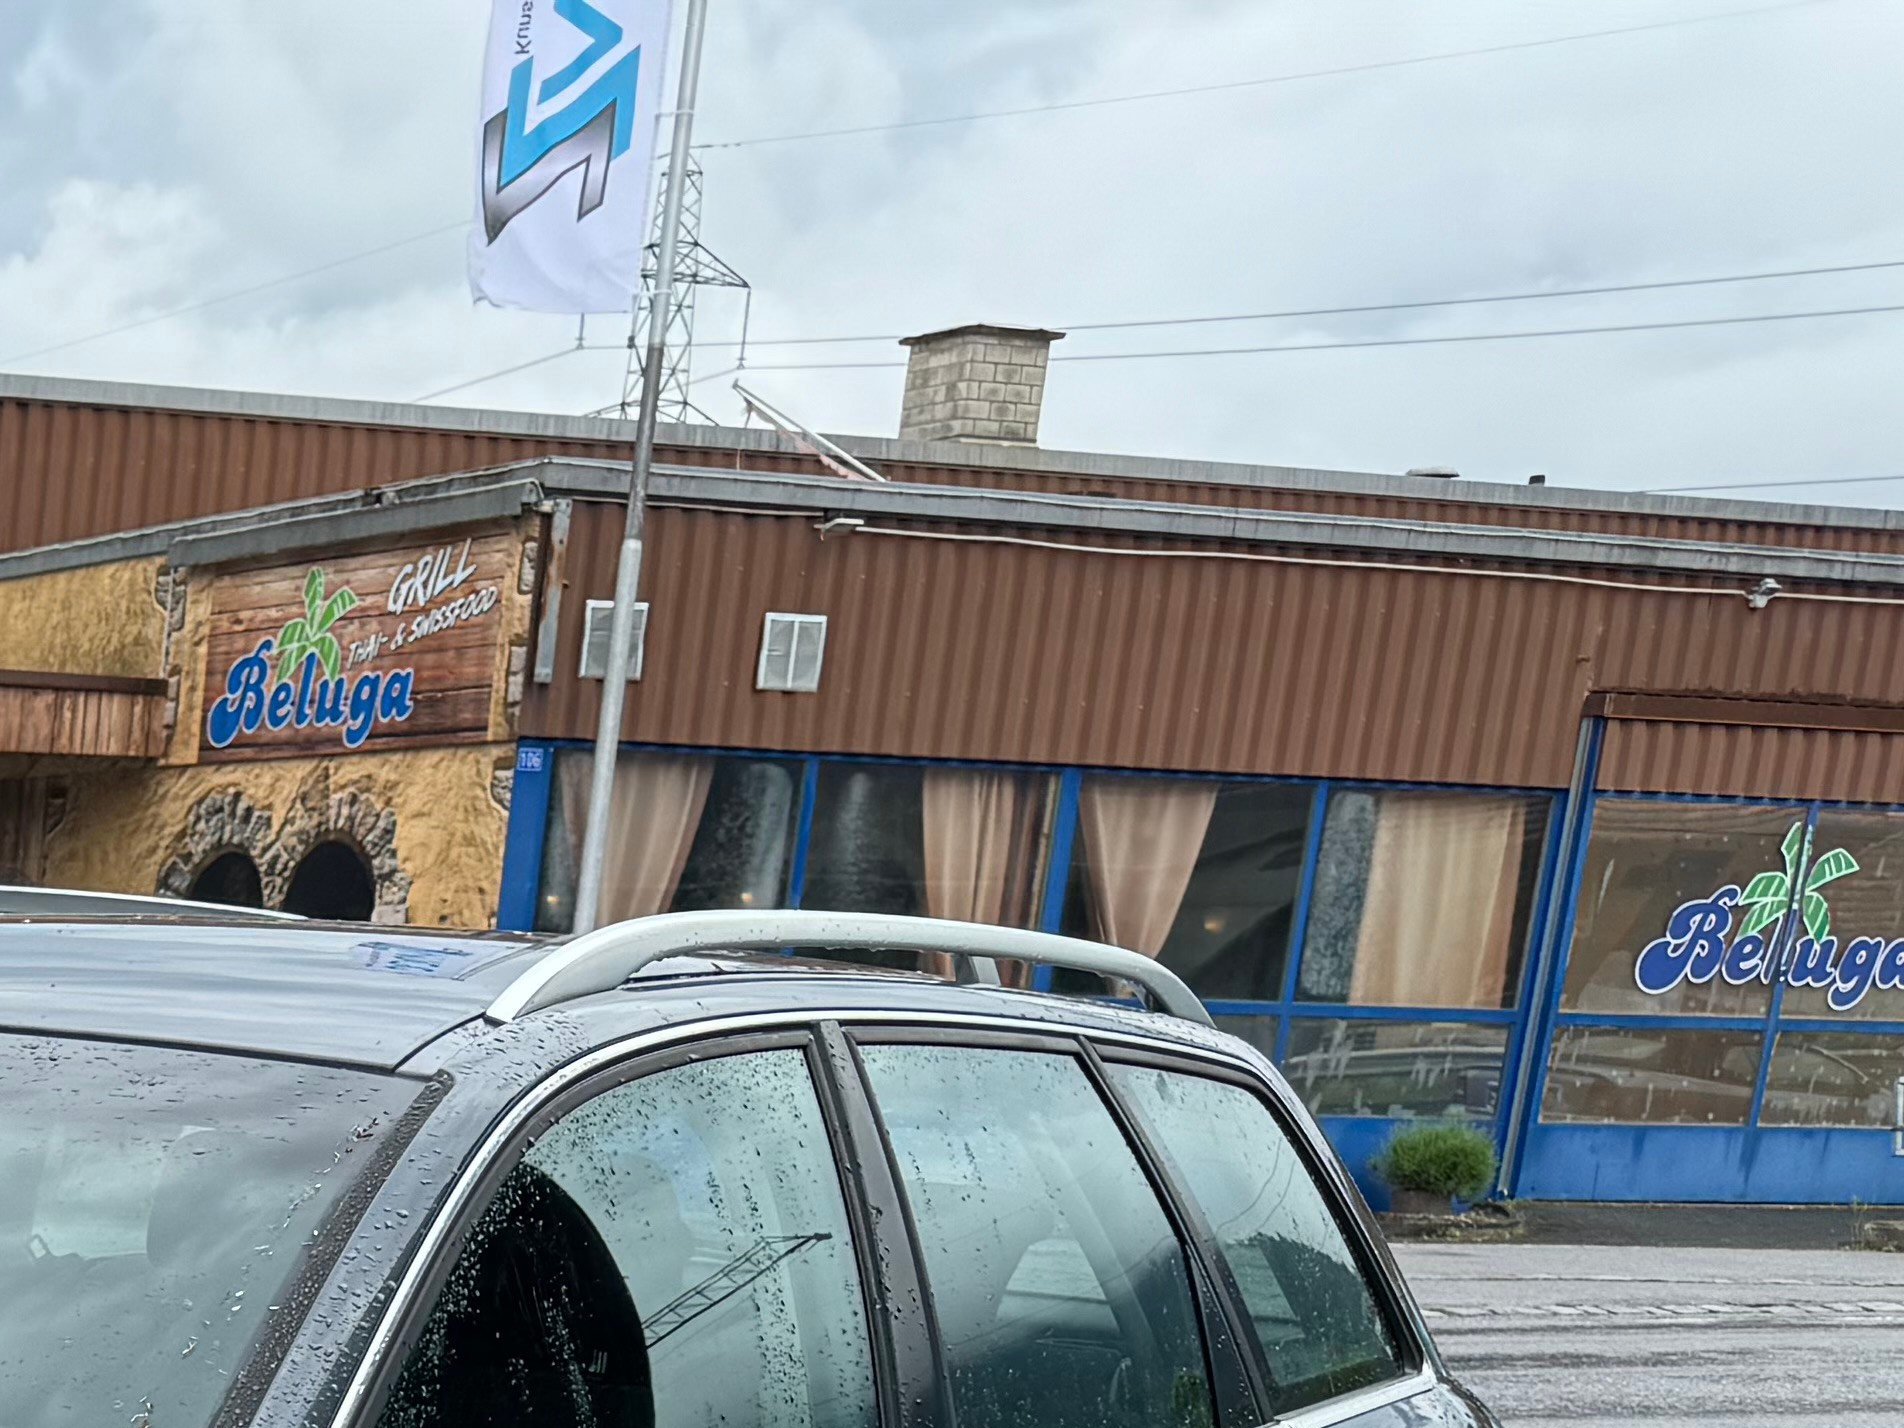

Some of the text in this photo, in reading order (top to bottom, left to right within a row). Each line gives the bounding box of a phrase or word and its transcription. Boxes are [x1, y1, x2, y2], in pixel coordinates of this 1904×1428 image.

[387, 537, 477, 615] GRILL
[391, 623, 407, 650] &
[408, 586, 499, 642] SWISSFOOD
[207, 635, 415, 748] Beluga
